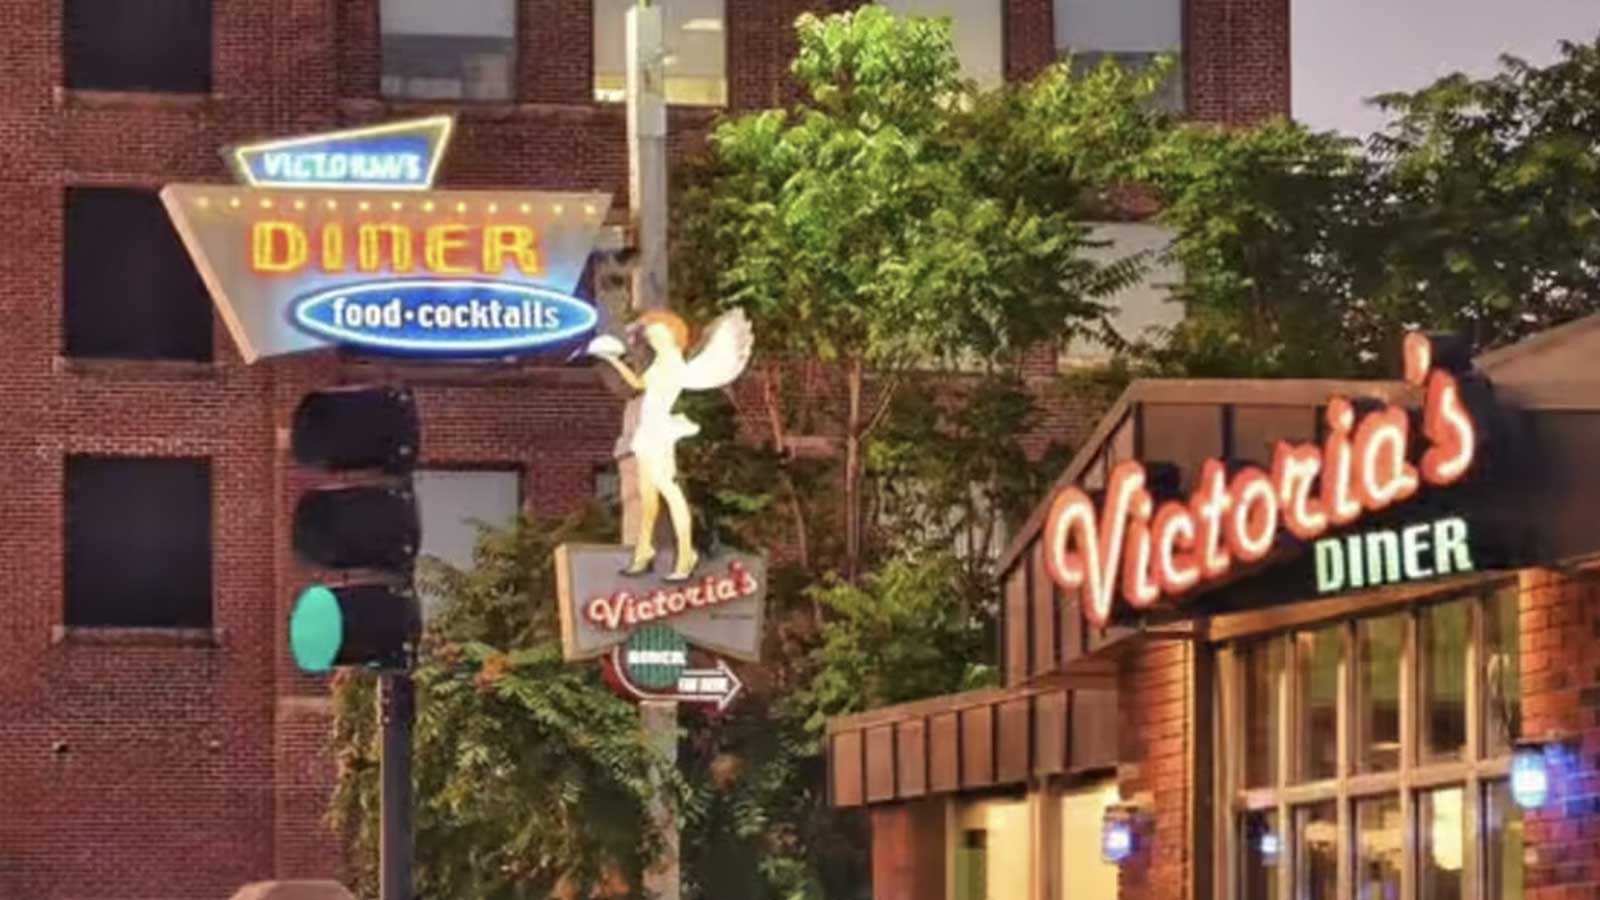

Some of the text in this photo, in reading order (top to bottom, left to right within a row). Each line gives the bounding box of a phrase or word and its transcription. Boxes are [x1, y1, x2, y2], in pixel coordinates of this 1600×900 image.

[250, 221, 541, 275] DINER
[1046, 331, 1475, 627] Victoria's
[1315, 517, 1473, 593] DINER
[586, 560, 758, 630] Victoria's
